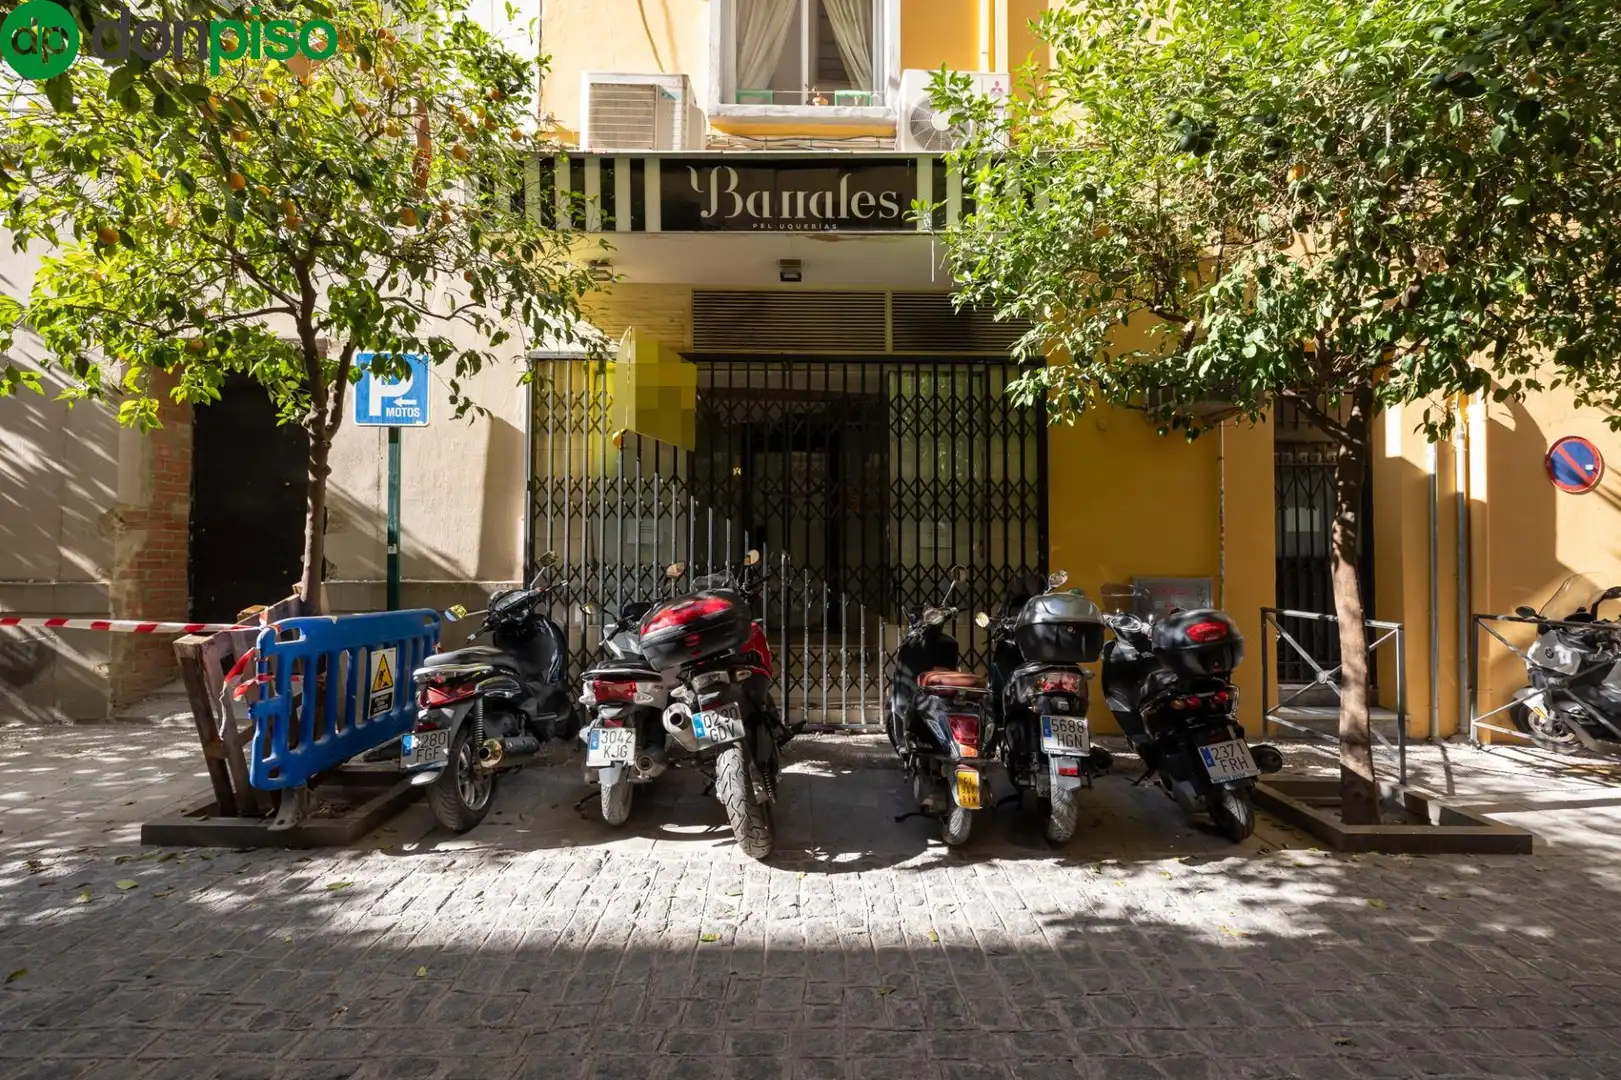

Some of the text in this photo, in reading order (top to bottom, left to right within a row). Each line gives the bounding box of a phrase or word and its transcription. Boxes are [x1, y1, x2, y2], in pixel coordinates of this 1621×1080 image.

[686, 165, 900, 219] Barrales
[752, 222, 838, 230] PELUQUERÍAS
[385, 407, 420, 418] MOTOS
[709, 723, 736, 743] GDV
[1051, 719, 1085, 733] 5688
[600, 729, 634, 744] 3042
[1057, 734, 1083, 749] HGN
[416, 745, 442, 763] FGF
[603, 745, 628, 758] KJG
[1210, 742, 1244, 761] 2371
[1220, 755, 1249, 773] FRH
